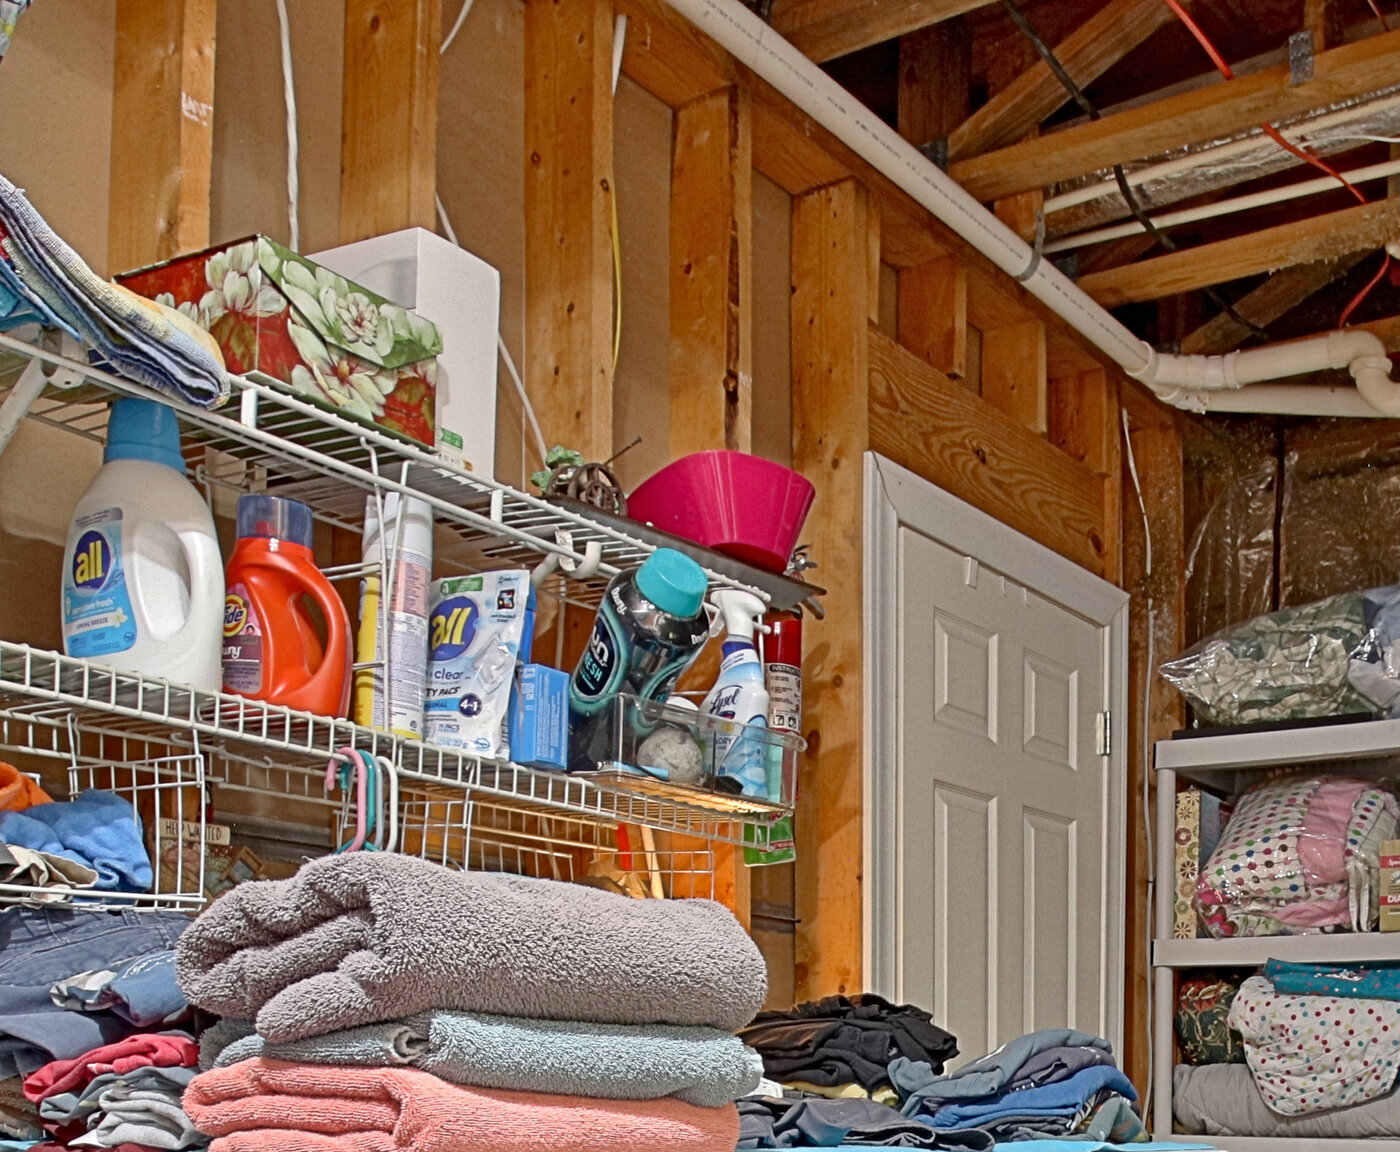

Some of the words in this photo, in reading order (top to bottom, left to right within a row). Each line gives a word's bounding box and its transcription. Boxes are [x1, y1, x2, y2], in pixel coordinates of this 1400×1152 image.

[75, 540, 105, 584] all
[611, 586, 628, 615] Downy
[432, 606, 473, 650] all
[434, 668, 464, 680] clear
[709, 685, 743, 716] Lysol
[187, 823, 222, 841] WATED
